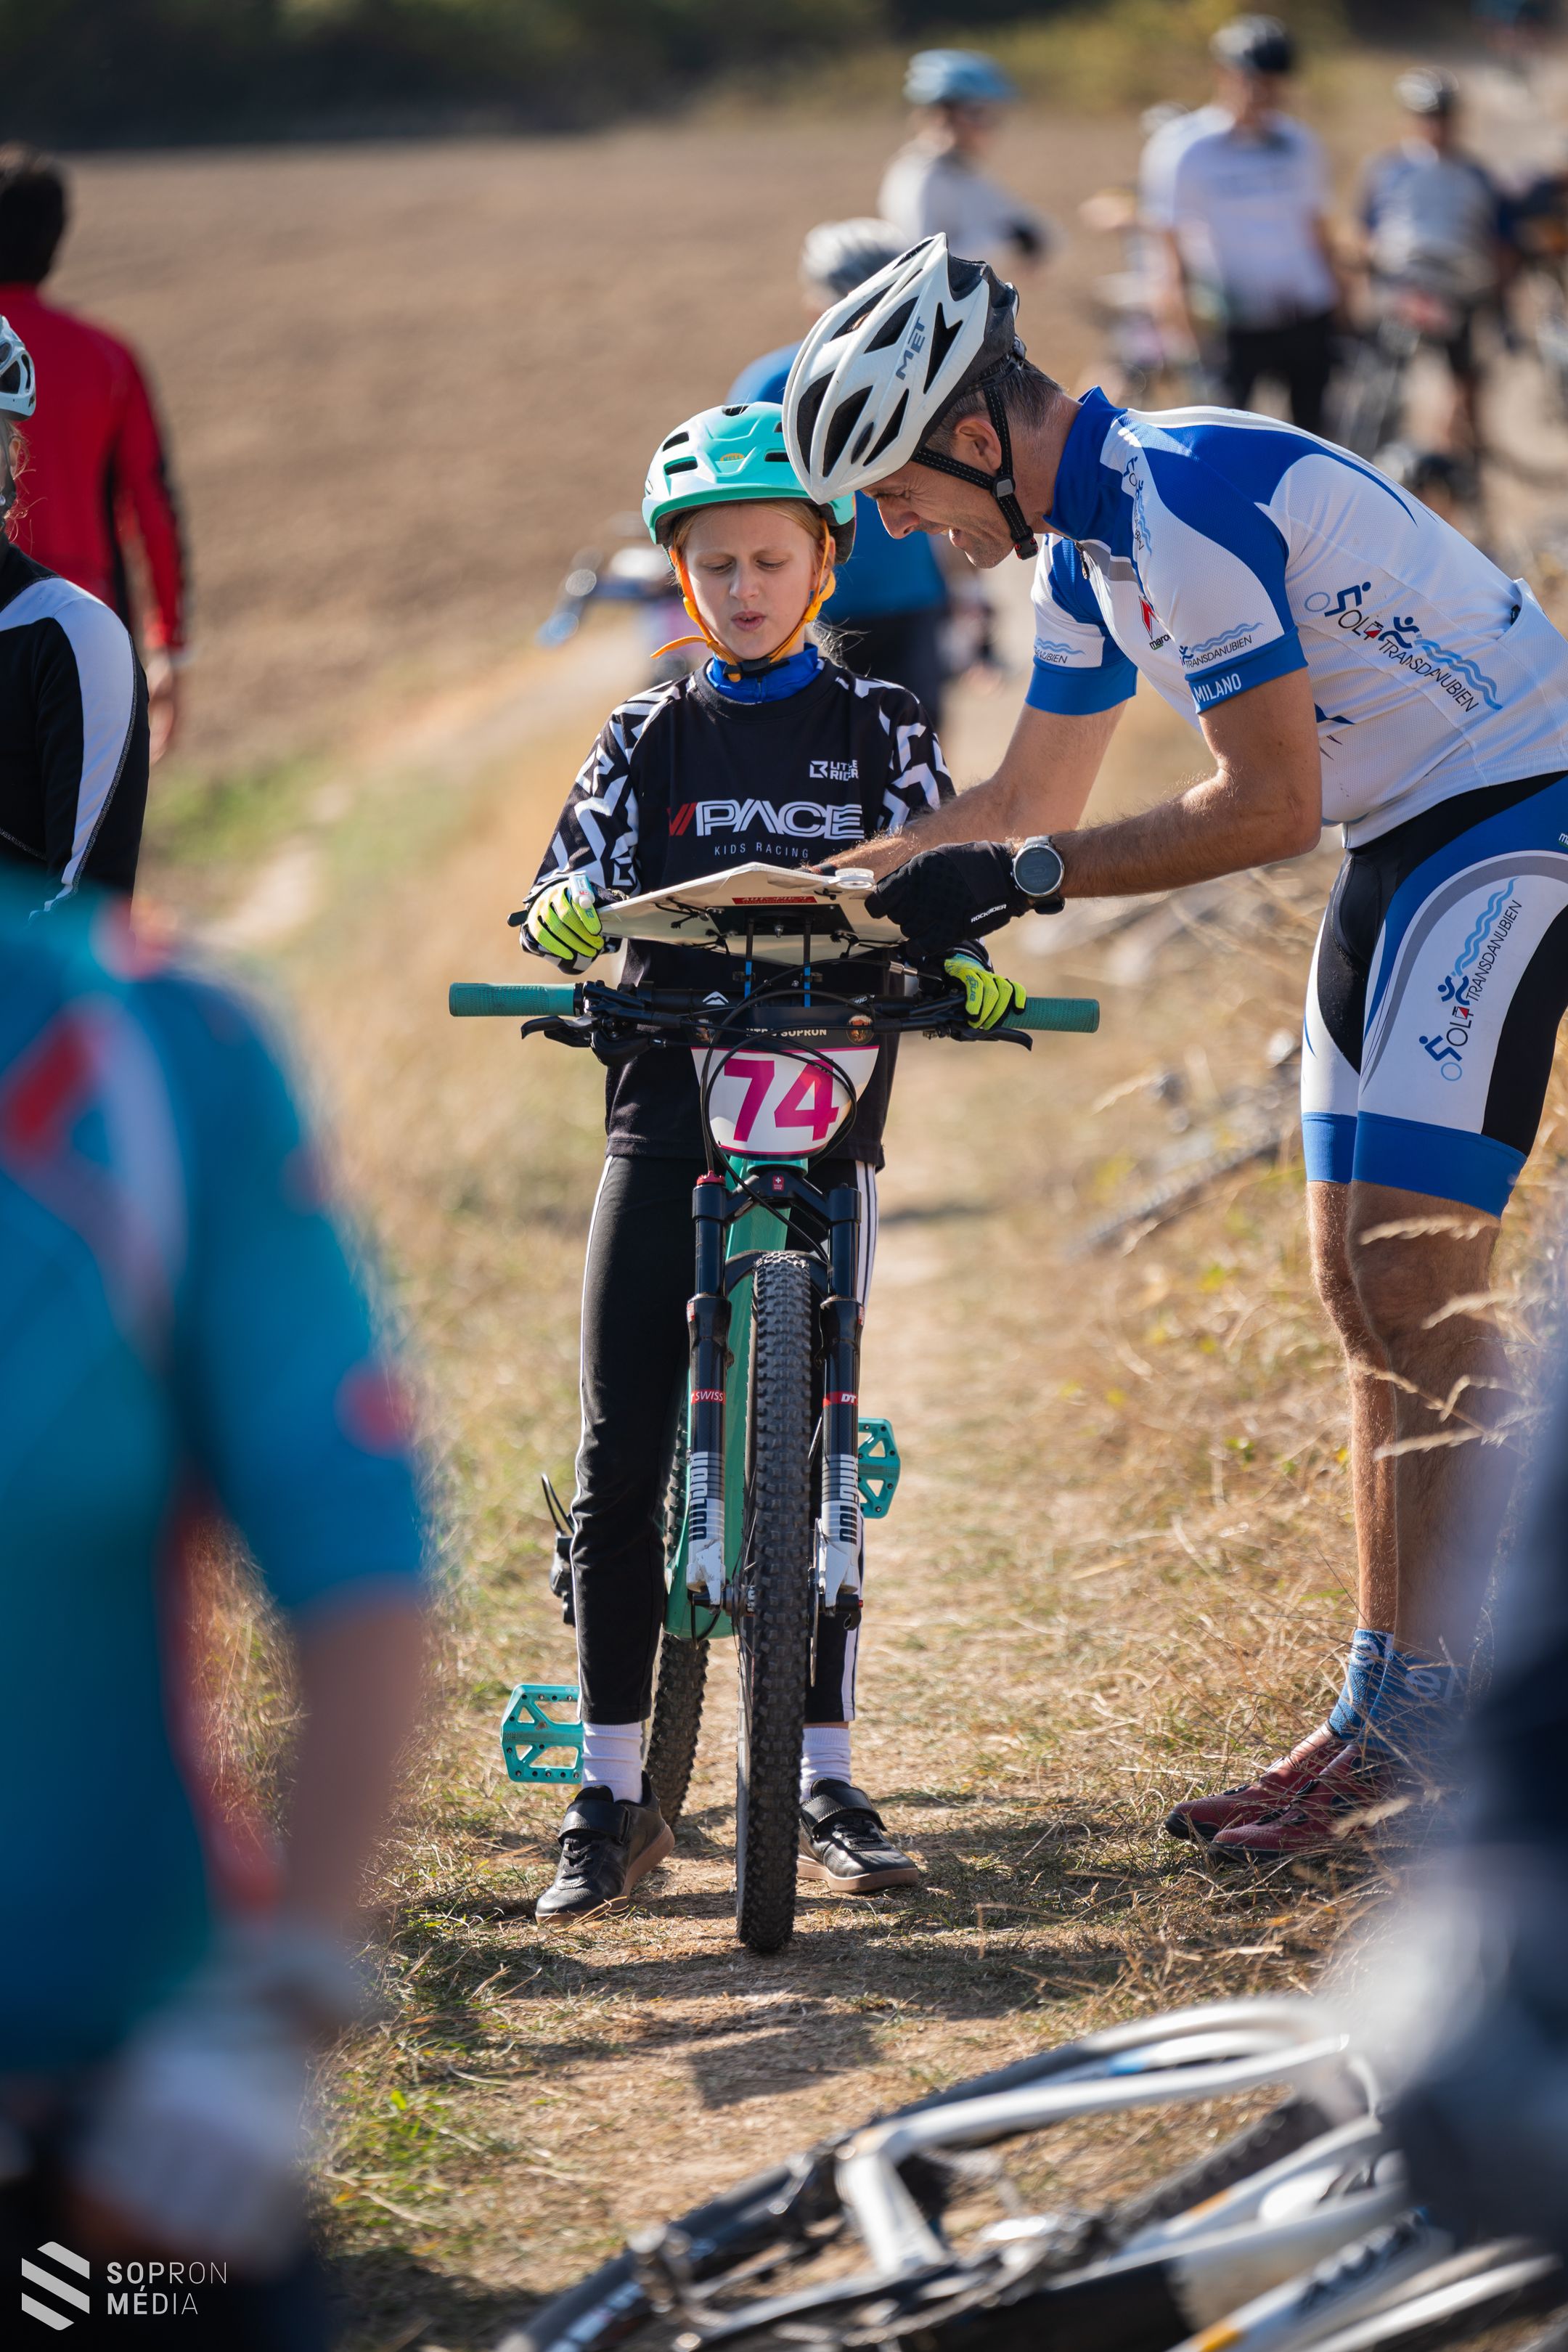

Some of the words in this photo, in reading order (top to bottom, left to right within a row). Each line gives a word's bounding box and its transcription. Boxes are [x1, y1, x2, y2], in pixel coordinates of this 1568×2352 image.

[895, 316, 926, 381] MET
[1185, 634, 1252, 669] TRANSDANUBIEN
[1193, 673, 1242, 703] MILANO
[714, 842, 746, 856] KIDS
[756, 842, 809, 859] RACING
[1466, 899, 1522, 1002] TRANSDANUBIEN
[724, 1058, 839, 1142] 74
[695, 1391, 723, 1402] SWISS
[841, 1393, 856, 1403] DT
